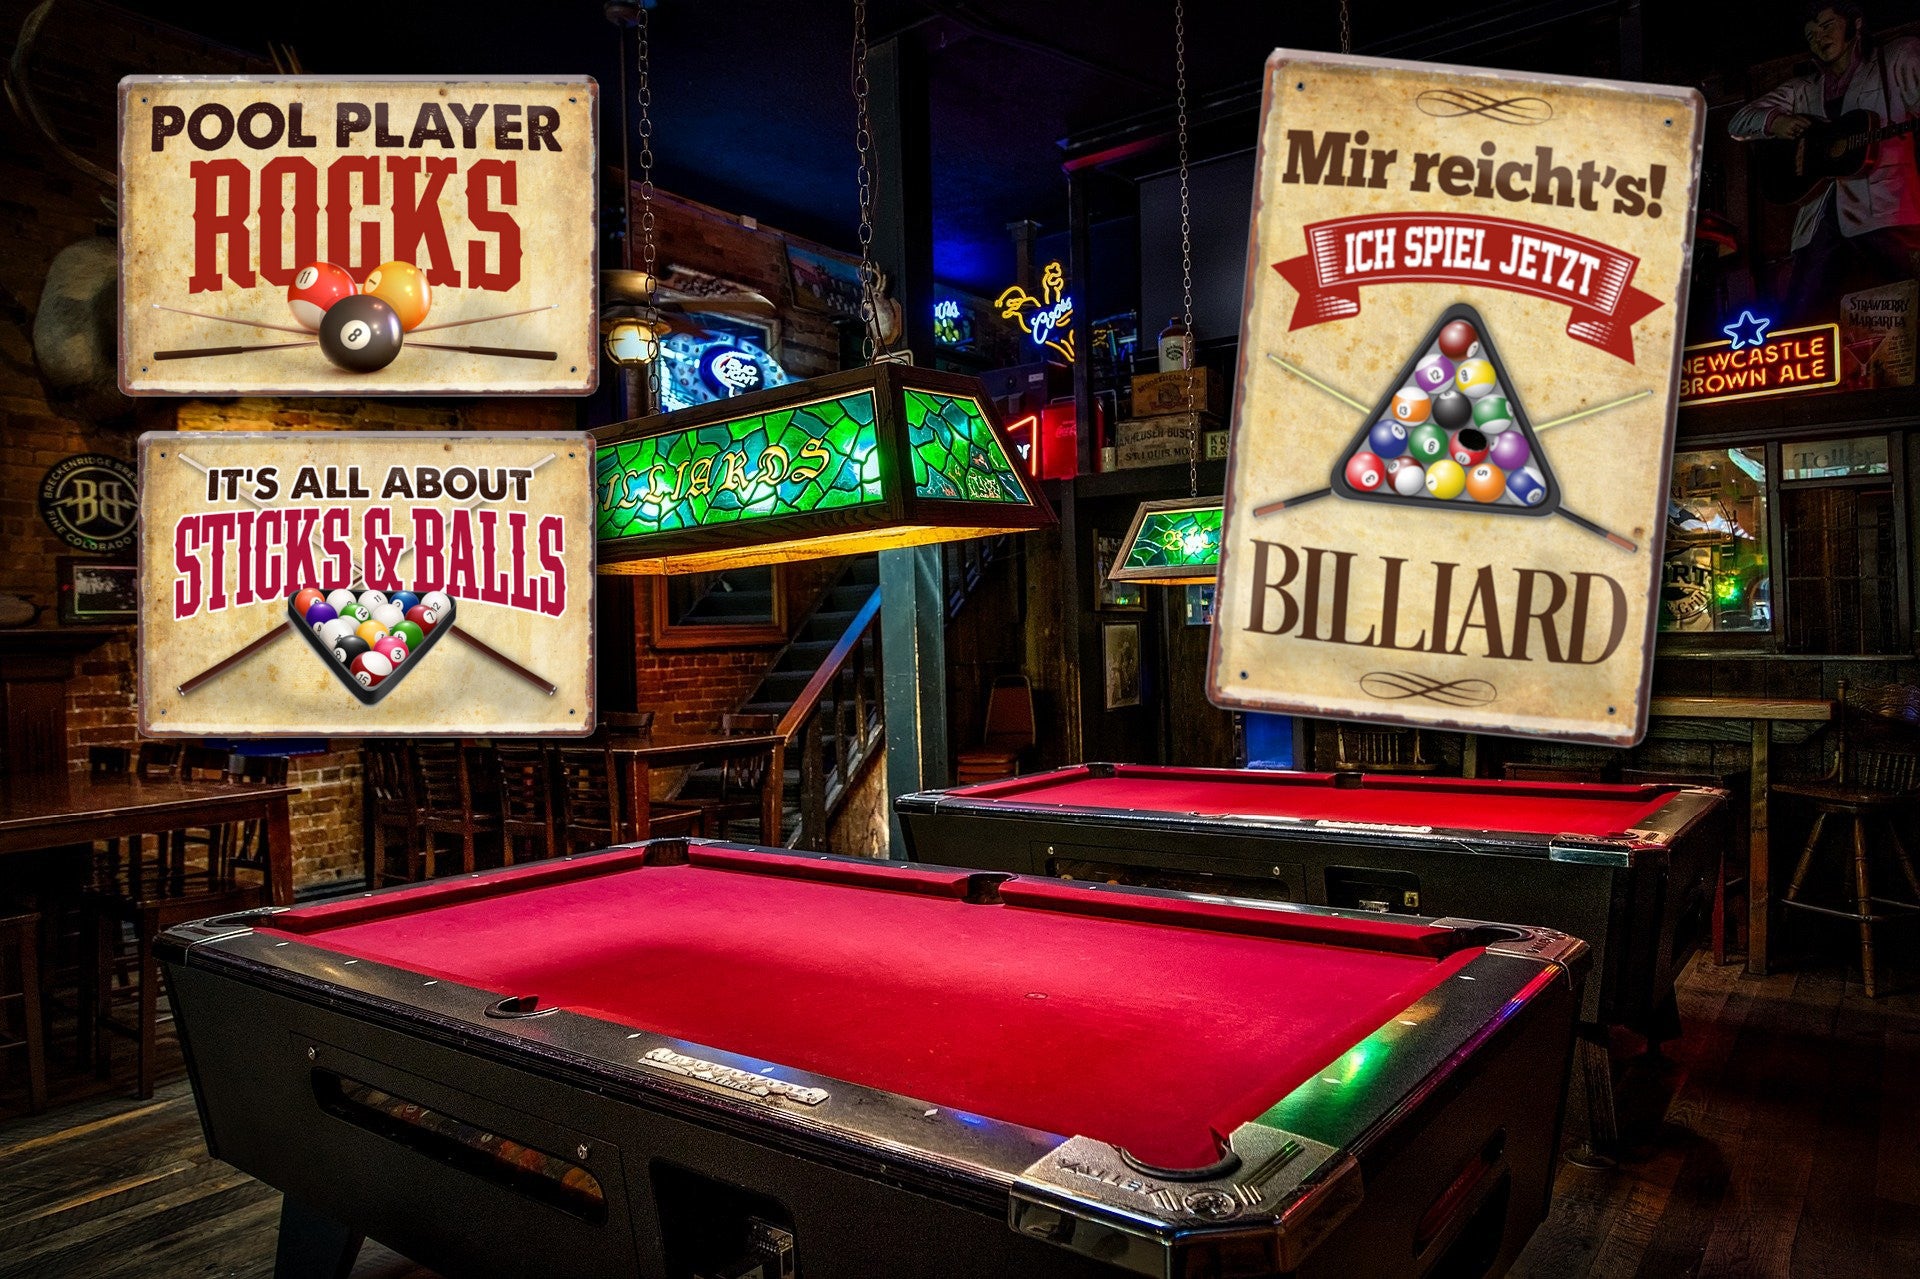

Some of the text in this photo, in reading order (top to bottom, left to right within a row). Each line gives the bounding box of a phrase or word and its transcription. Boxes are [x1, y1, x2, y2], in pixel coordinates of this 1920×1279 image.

[151, 102, 563, 152] POOL PLAYER
[1281, 129, 1666, 219] Mir reicht's!
[189, 155, 523, 293] ROCKS
[299, 271, 312, 284] 11
[1344, 226, 1600, 296] ICH SPIEL JETZT
[1849, 297, 1910, 312] STRAWBERRY
[348, 328, 362, 342] 8
[1429, 368, 1441, 381] 12
[1679, 359, 1826, 396] BROWN ALE
[1399, 405, 1409, 417] 13
[43, 456, 112, 499] BRECKENRIDGE
[206, 466, 533, 501] IT'S ALL ABOUT
[46, 510, 132, 551] FINE COLORADO
[174, 506, 567, 620] STICKS & BALLS
[1243, 539, 1628, 665] BILLIARD
